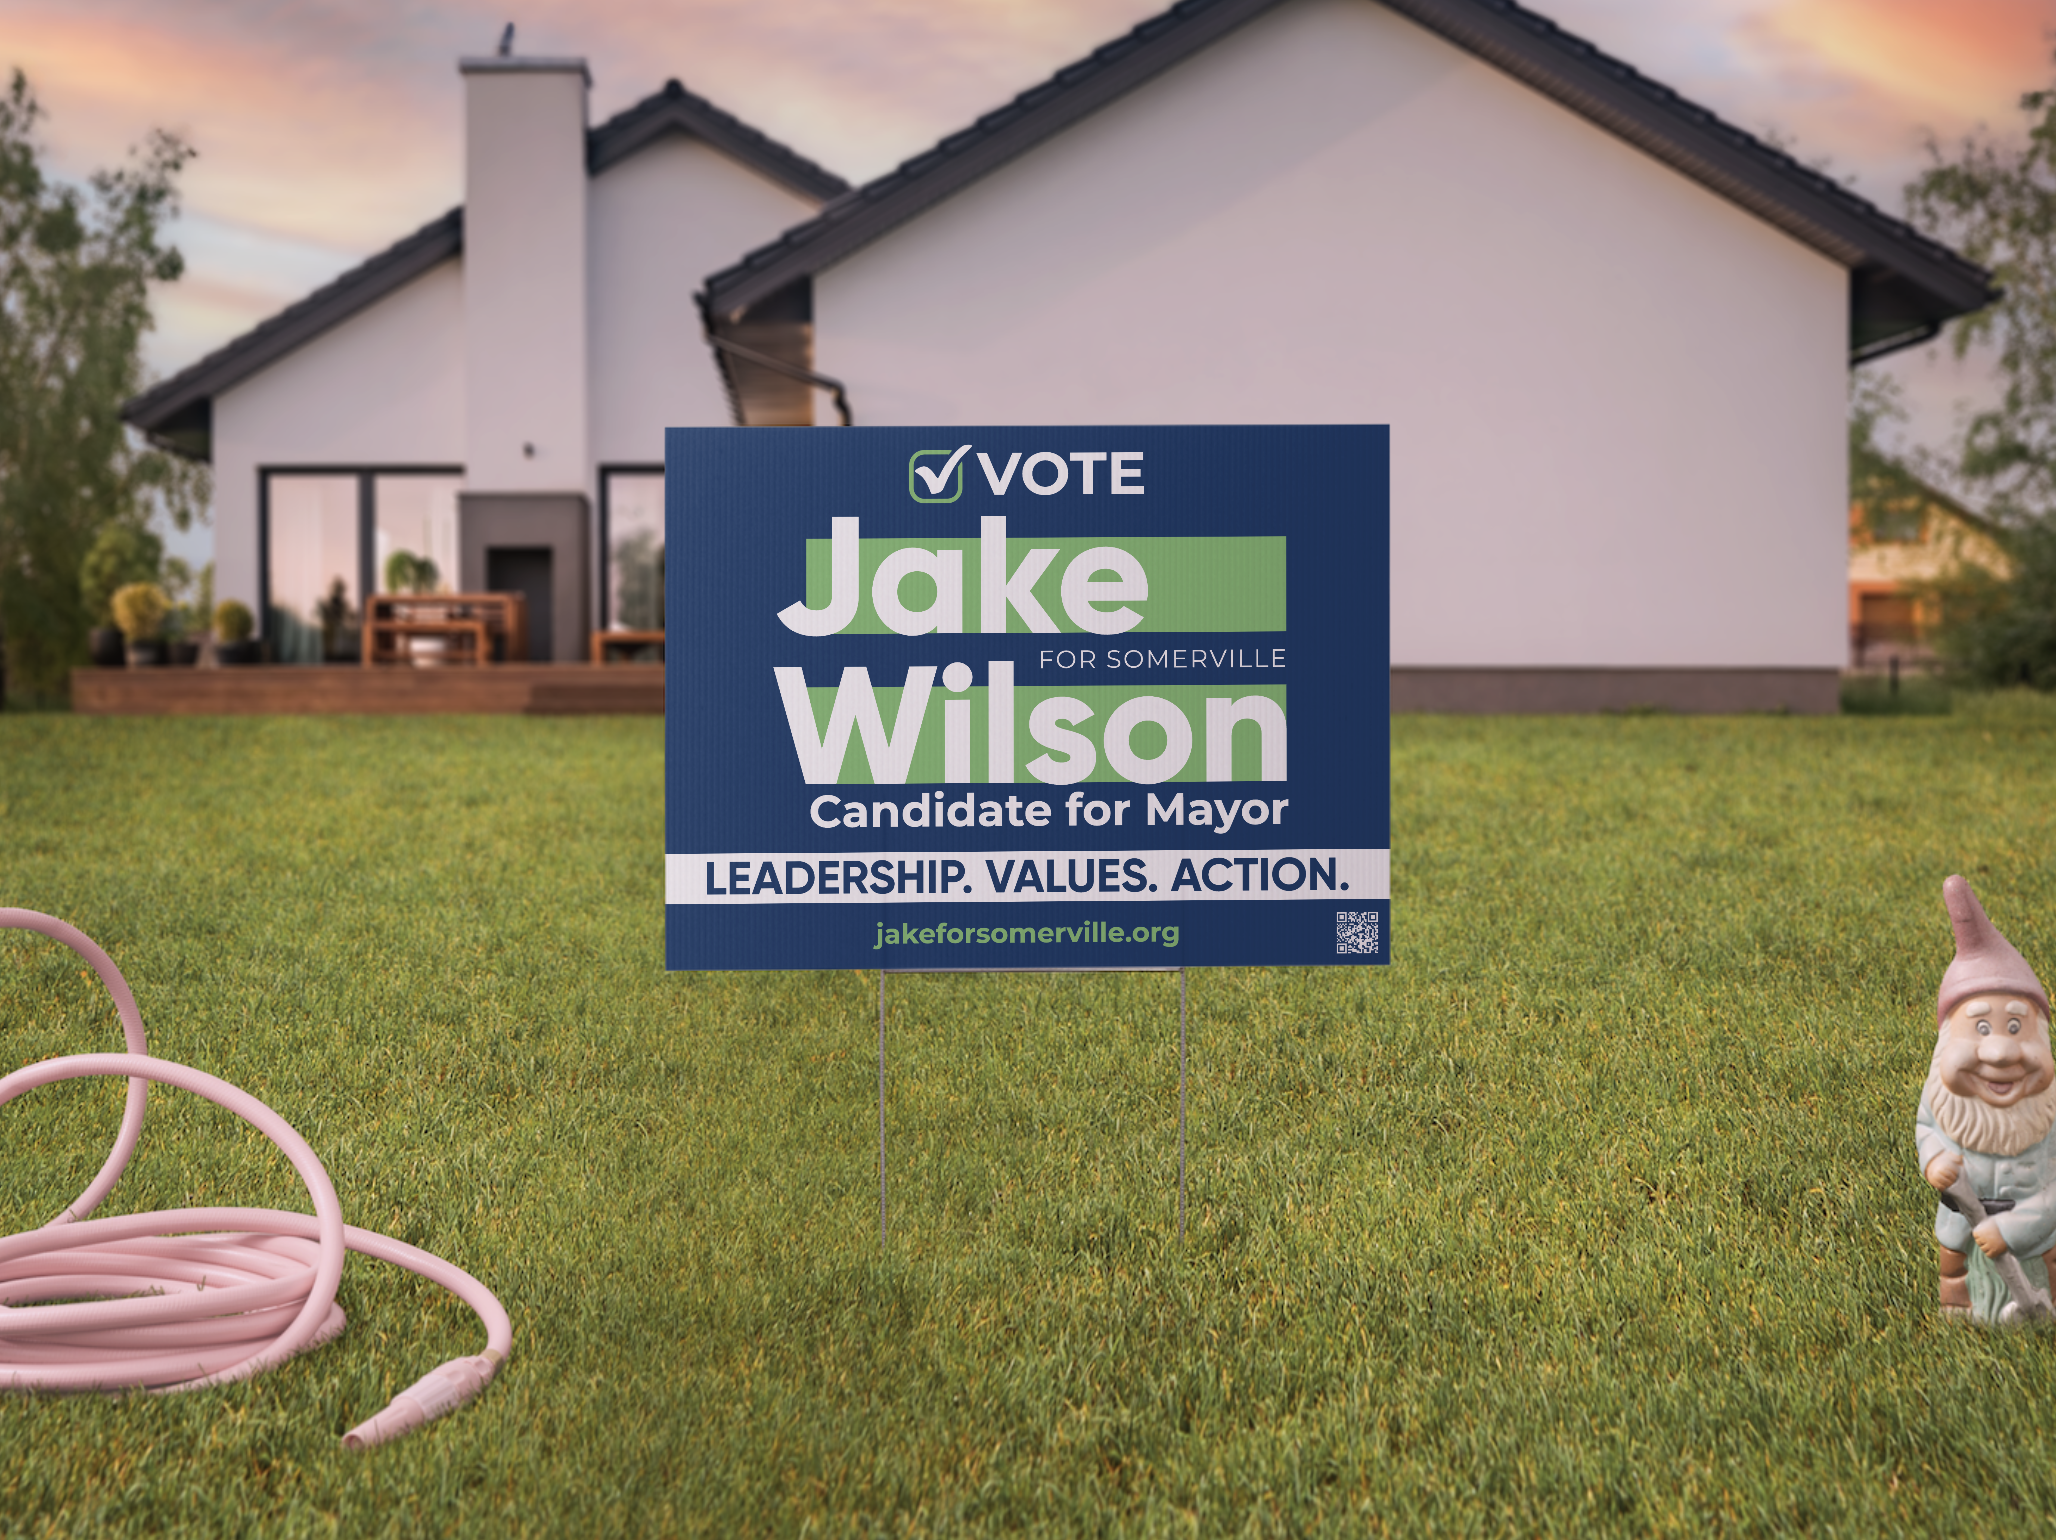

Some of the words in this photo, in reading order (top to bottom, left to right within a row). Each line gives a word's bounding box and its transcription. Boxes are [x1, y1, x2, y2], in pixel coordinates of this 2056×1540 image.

[977, 451, 1145, 496] VOTE
[776, 516, 1149, 637] Jake
[1040, 649, 1096, 669] FOR
[1107, 648, 1287, 669] SOMERVILLE
[774, 660, 1287, 786] Wilson
[810, 790, 1052, 829] Candidate
[1065, 791, 1131, 827] for
[1147, 791, 1289, 835] Mayor
[706, 859, 972, 896] LEADERSHIP.
[985, 858, 1158, 894] VALUES.
[1170, 856, 1350, 893] ACTION.
[873, 920, 1180, 950] jakeforsomerville.org
